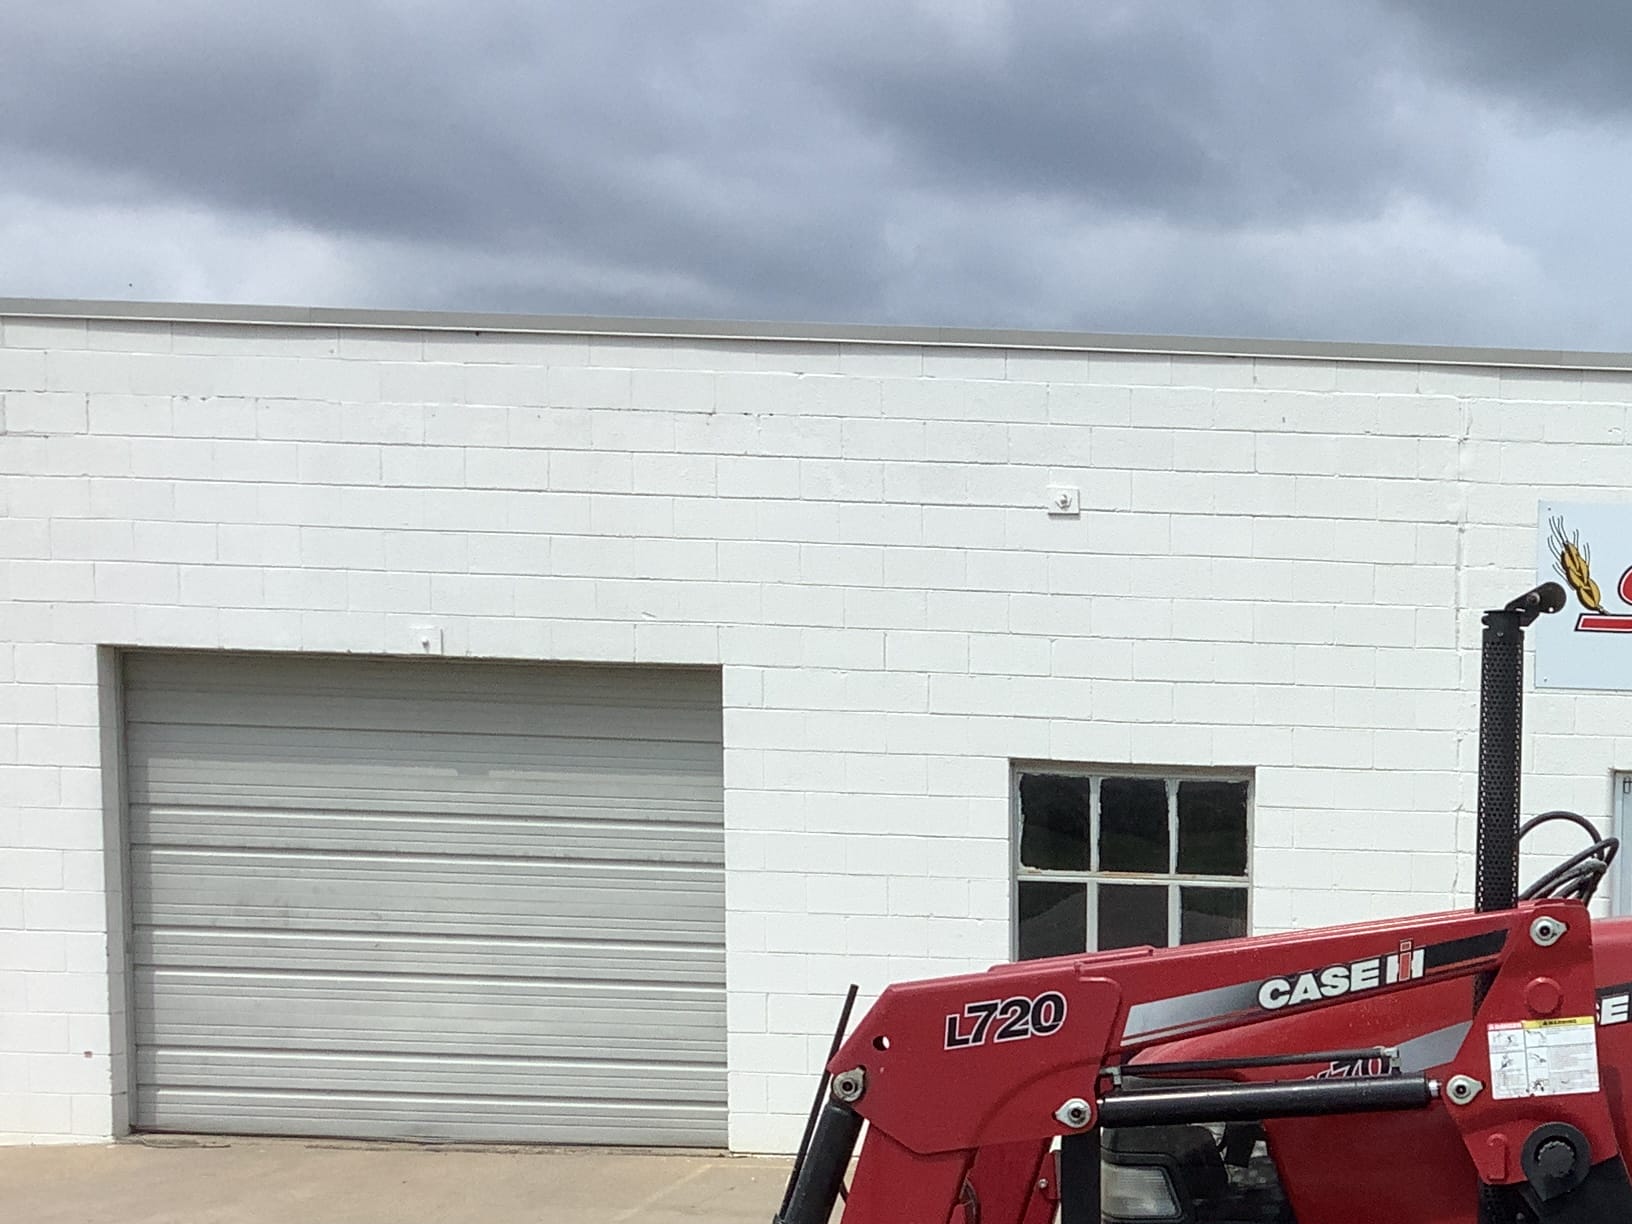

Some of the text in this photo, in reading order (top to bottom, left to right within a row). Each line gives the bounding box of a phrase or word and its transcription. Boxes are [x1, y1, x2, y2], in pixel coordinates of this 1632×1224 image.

[1257, 957, 1381, 1011] CASE
[1595, 994, 1630, 1026] E
[943, 990, 1068, 1051] L720
